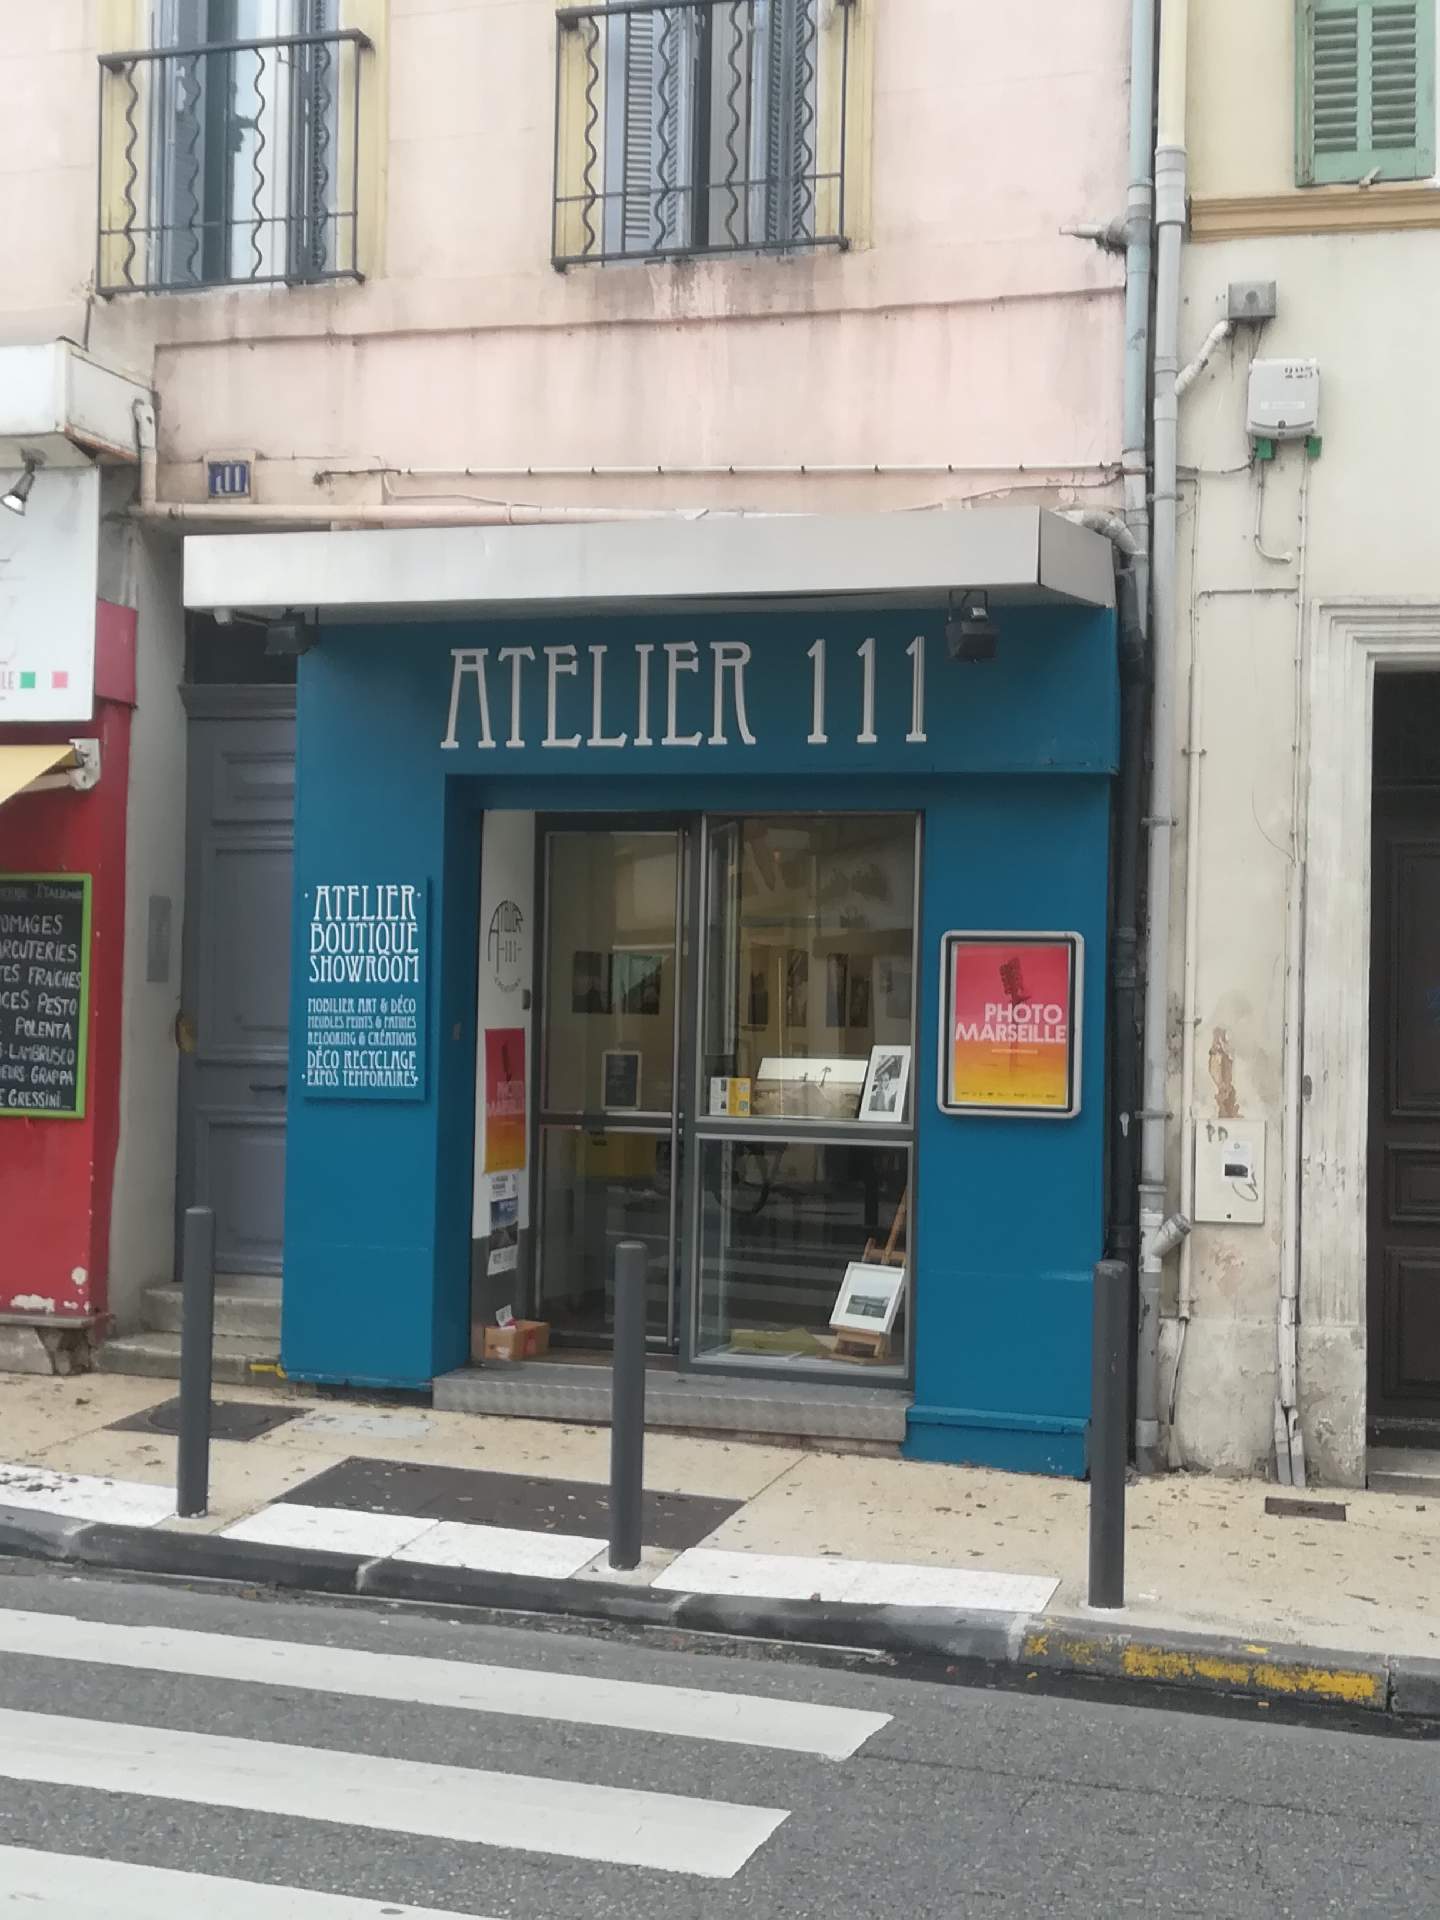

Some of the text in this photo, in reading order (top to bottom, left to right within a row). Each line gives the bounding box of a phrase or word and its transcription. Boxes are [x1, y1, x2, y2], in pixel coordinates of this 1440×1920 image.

[441, 636, 926, 748] ATELIER 111
[313, 885, 417, 921] ATELIER
[310, 922, 419, 955] BOUTIQUE
[309, 955, 419, 983] SHOWROOM
[37, 992, 77, 1016] PESTO
[308, 994, 416, 1014] MOBILIER ART & DÉCO
[984, 1003, 1063, 1024] PHOTO
[15, 1016, 72, 1040] POLENTA
[308, 1016, 344, 1029] MEUBLES
[375, 1016, 382, 1029] &
[955, 1022, 1067, 1043] MARSEILLE
[307, 1031, 356, 1045] RELOOKING
[358, 1031, 366, 1045] &
[307, 1046, 416, 1070] DÉCO RECYCLAGE
[31, 1065, 74, 1086] GRAPPA
[307, 1069, 416, 1087] EXPOS TEMPORAIRES
